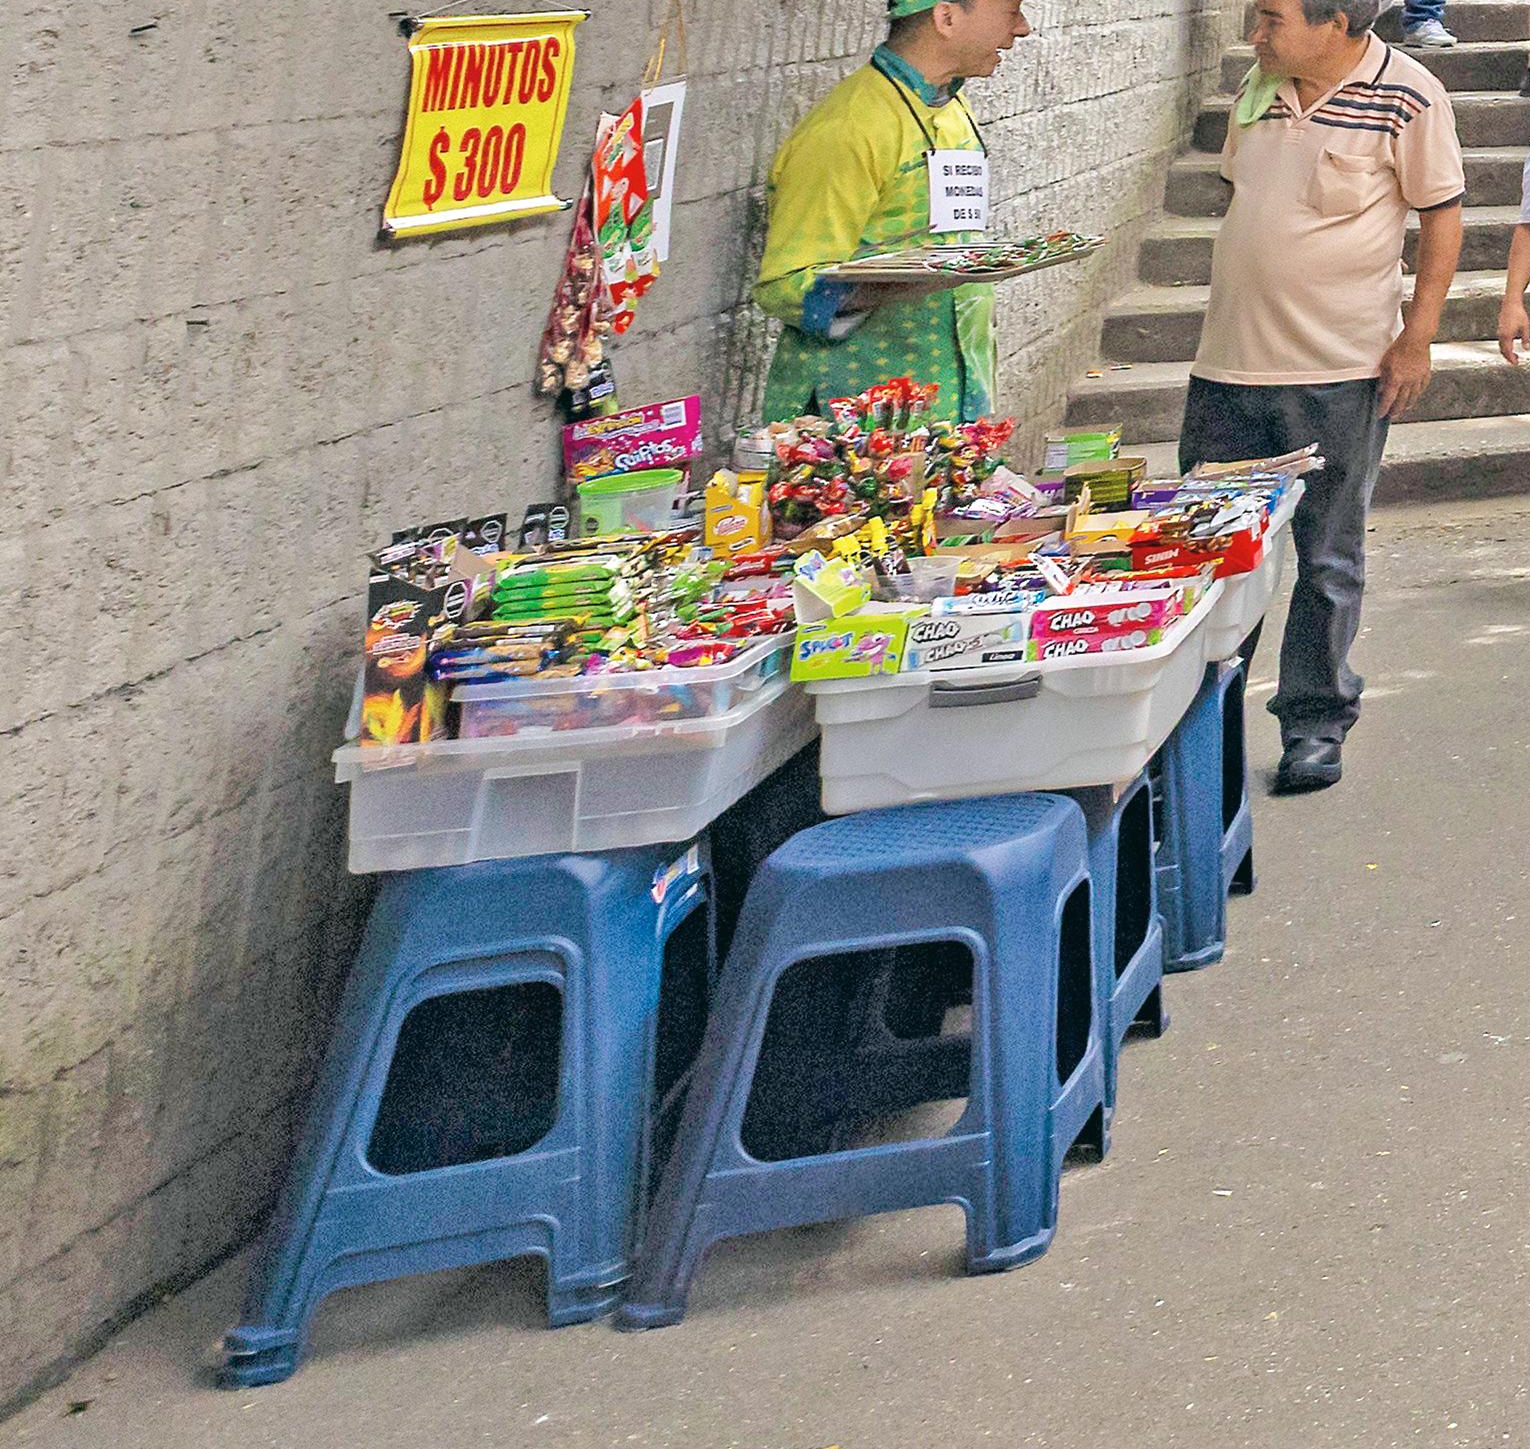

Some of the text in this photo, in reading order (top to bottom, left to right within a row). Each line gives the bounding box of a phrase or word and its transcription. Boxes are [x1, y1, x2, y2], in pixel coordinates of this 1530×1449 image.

[422, 36, 561, 112] MINUTOS
[422, 125, 450, 212] $
[453, 122, 527, 202] 300
[943, 165, 952, 176] SI
[953, 208, 966, 219] DE
[1050, 610, 1096, 630] CHAO
[910, 620, 960, 644] CHAO
[1042, 639, 1089, 659] CHAO
